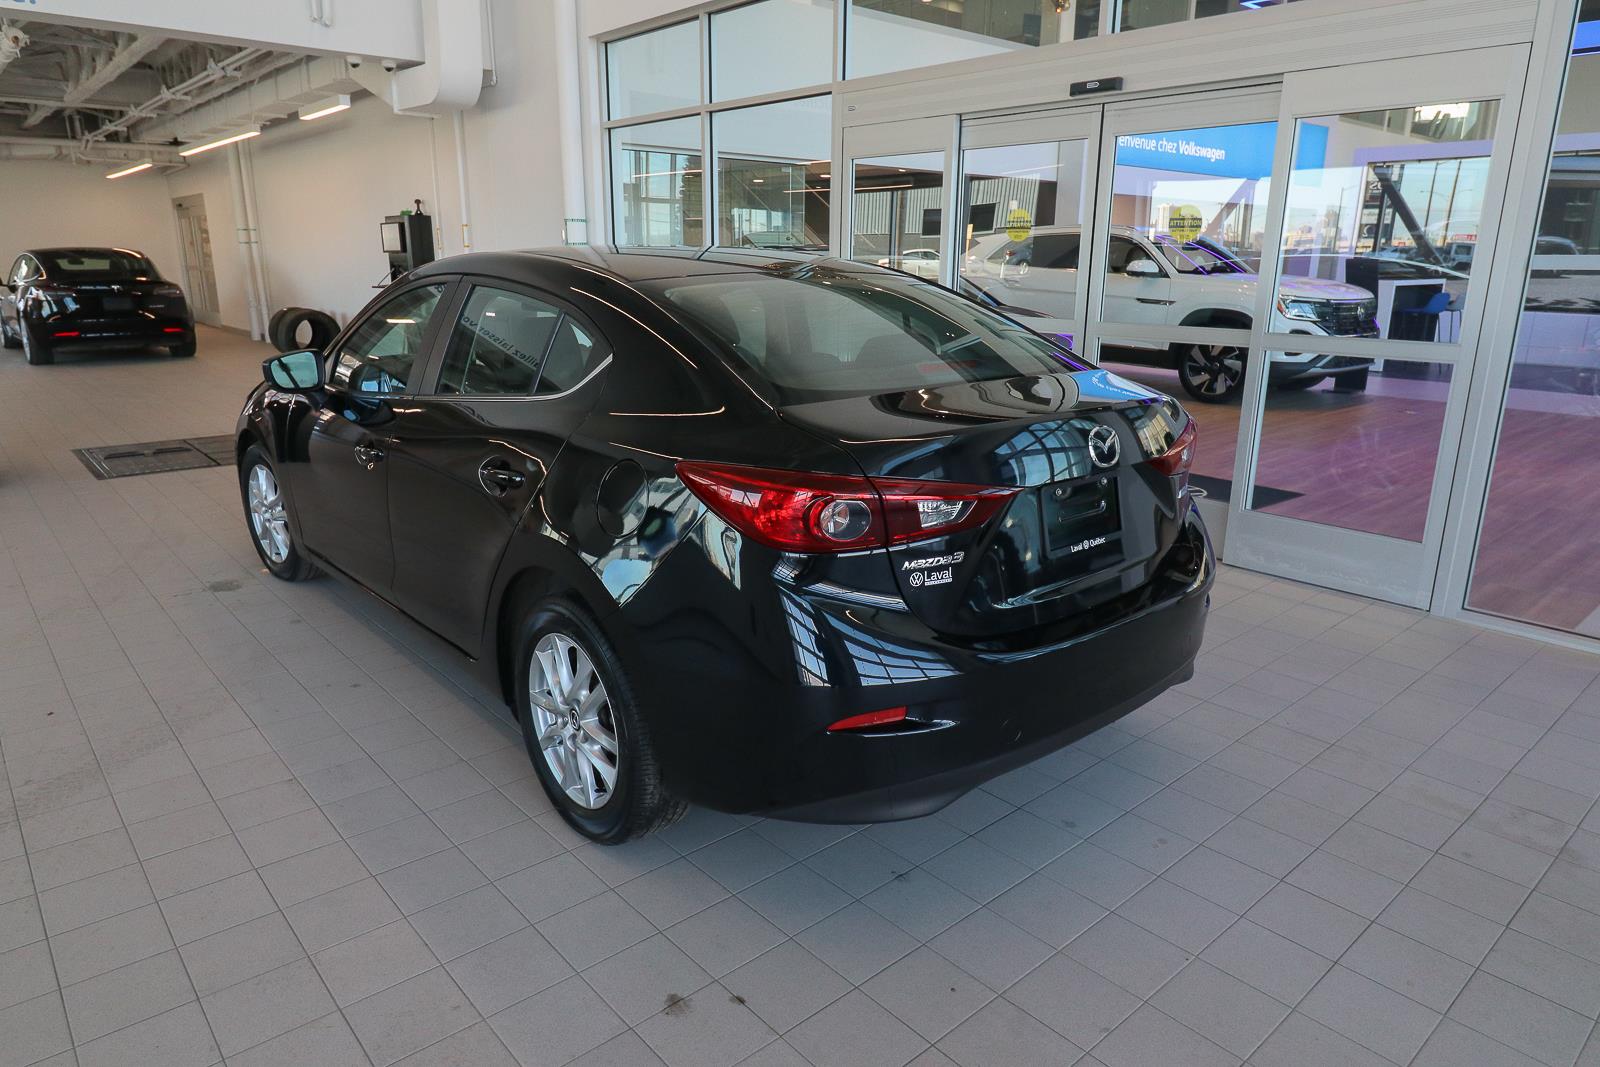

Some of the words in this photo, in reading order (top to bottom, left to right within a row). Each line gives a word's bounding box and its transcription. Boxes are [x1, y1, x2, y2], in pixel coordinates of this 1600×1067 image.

[1157, 138, 1177, 154] chez
[1179, 139, 1226, 162] Volkswagen
[924, 566, 953, 582] Laval
